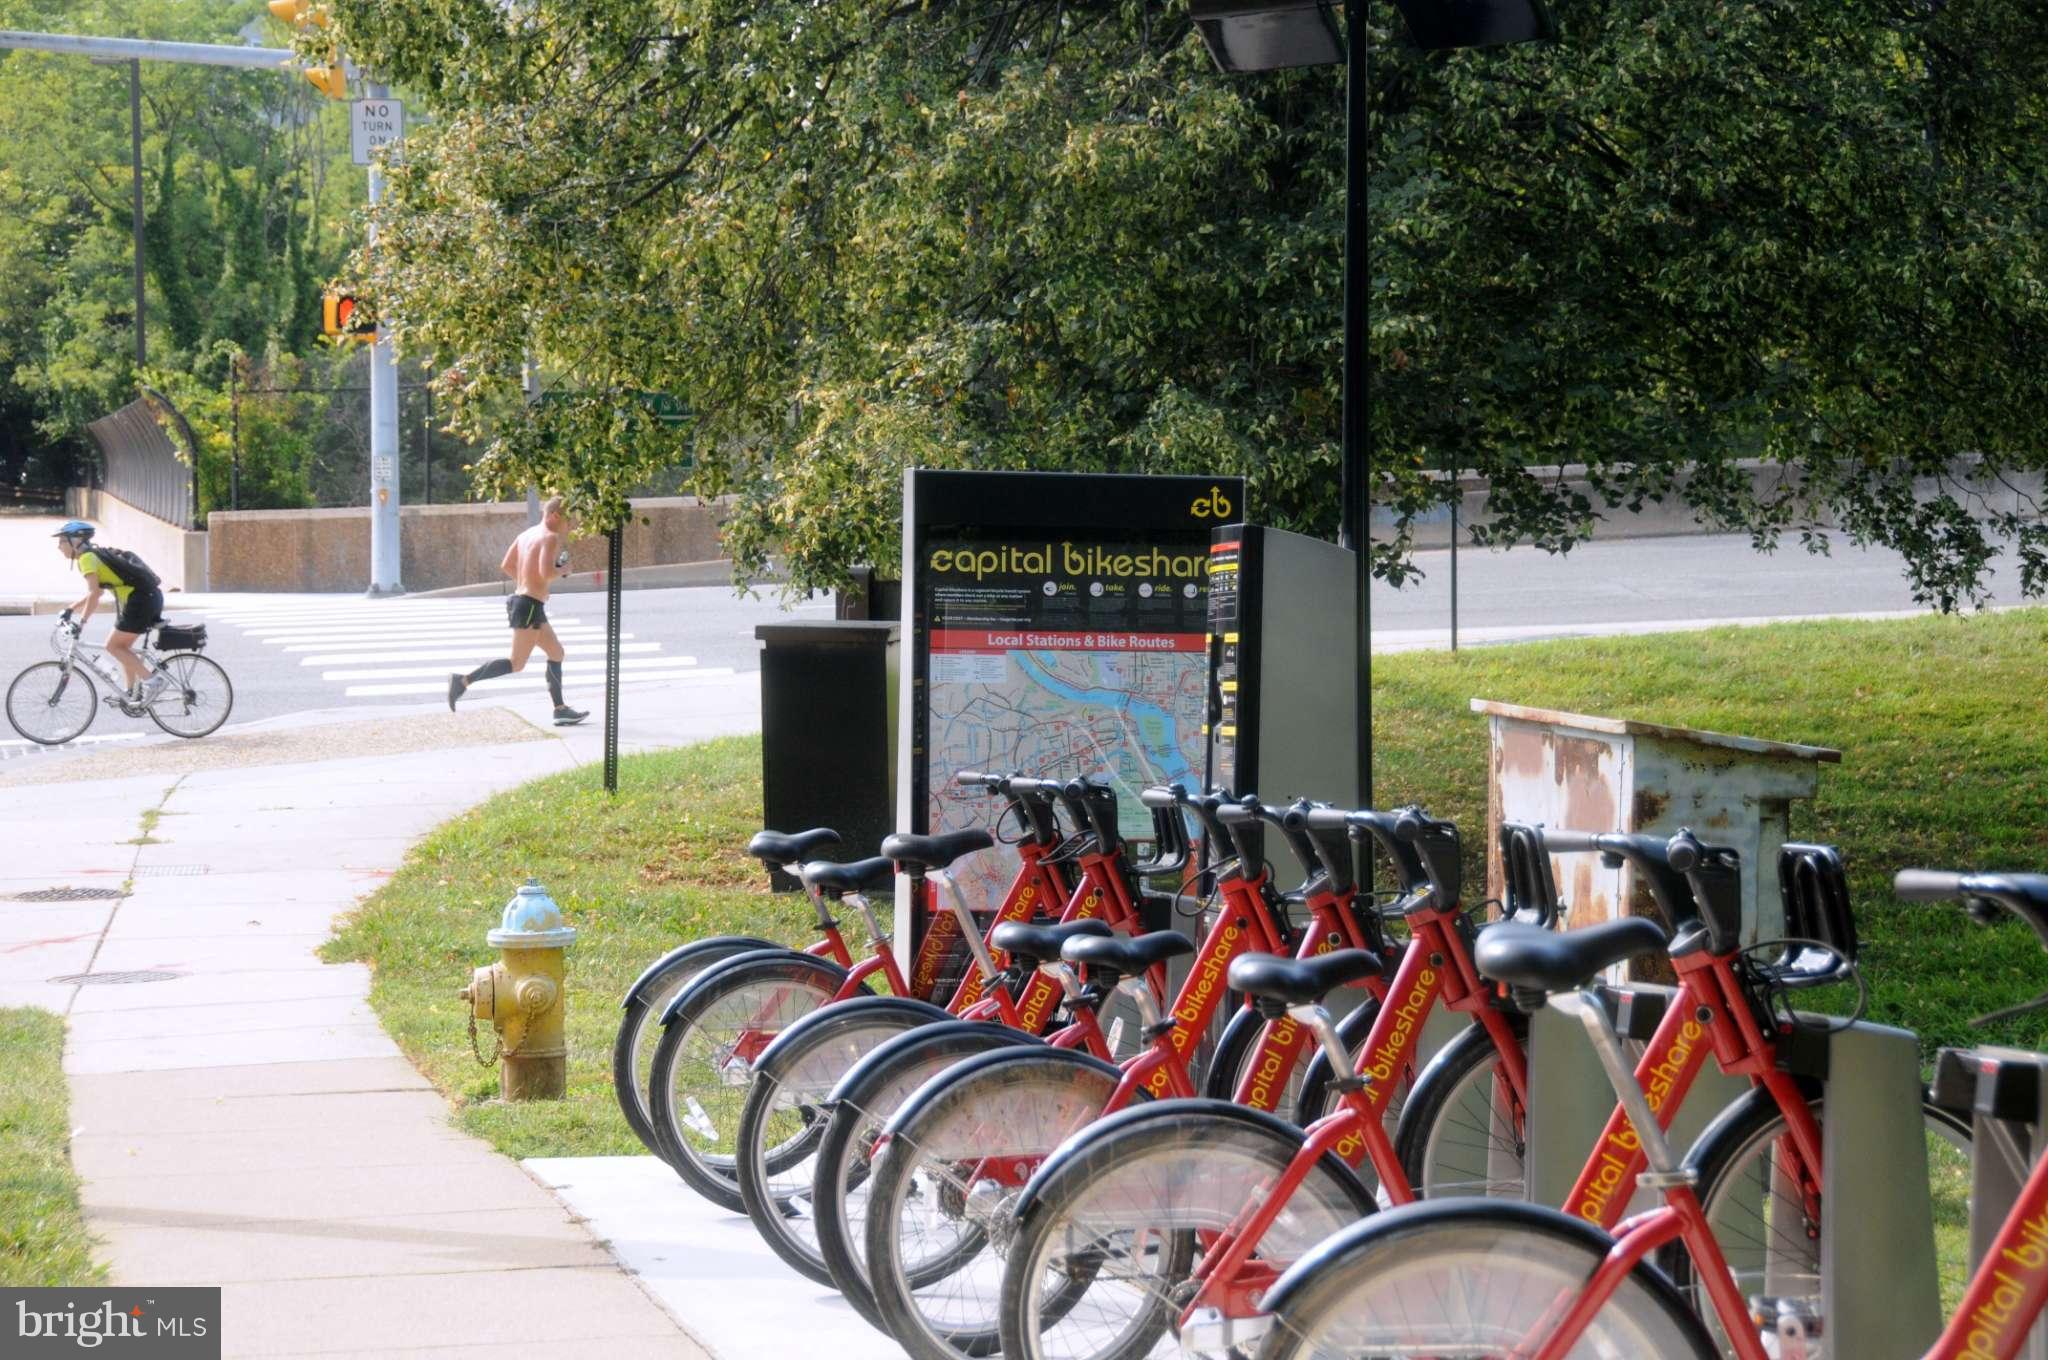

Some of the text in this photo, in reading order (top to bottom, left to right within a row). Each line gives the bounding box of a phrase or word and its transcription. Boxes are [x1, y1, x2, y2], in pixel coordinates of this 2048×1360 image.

[365, 104, 389, 118] NO
[361, 120, 392, 131] TURN
[369, 135, 386, 146] ON
[930, 543, 1052, 581] capital
[987, 633, 1175, 649] Local Stations & Bike Routes
[1174, 926, 1238, 1022] bikeshare
[1363, 969, 1436, 1081] bikeshare
